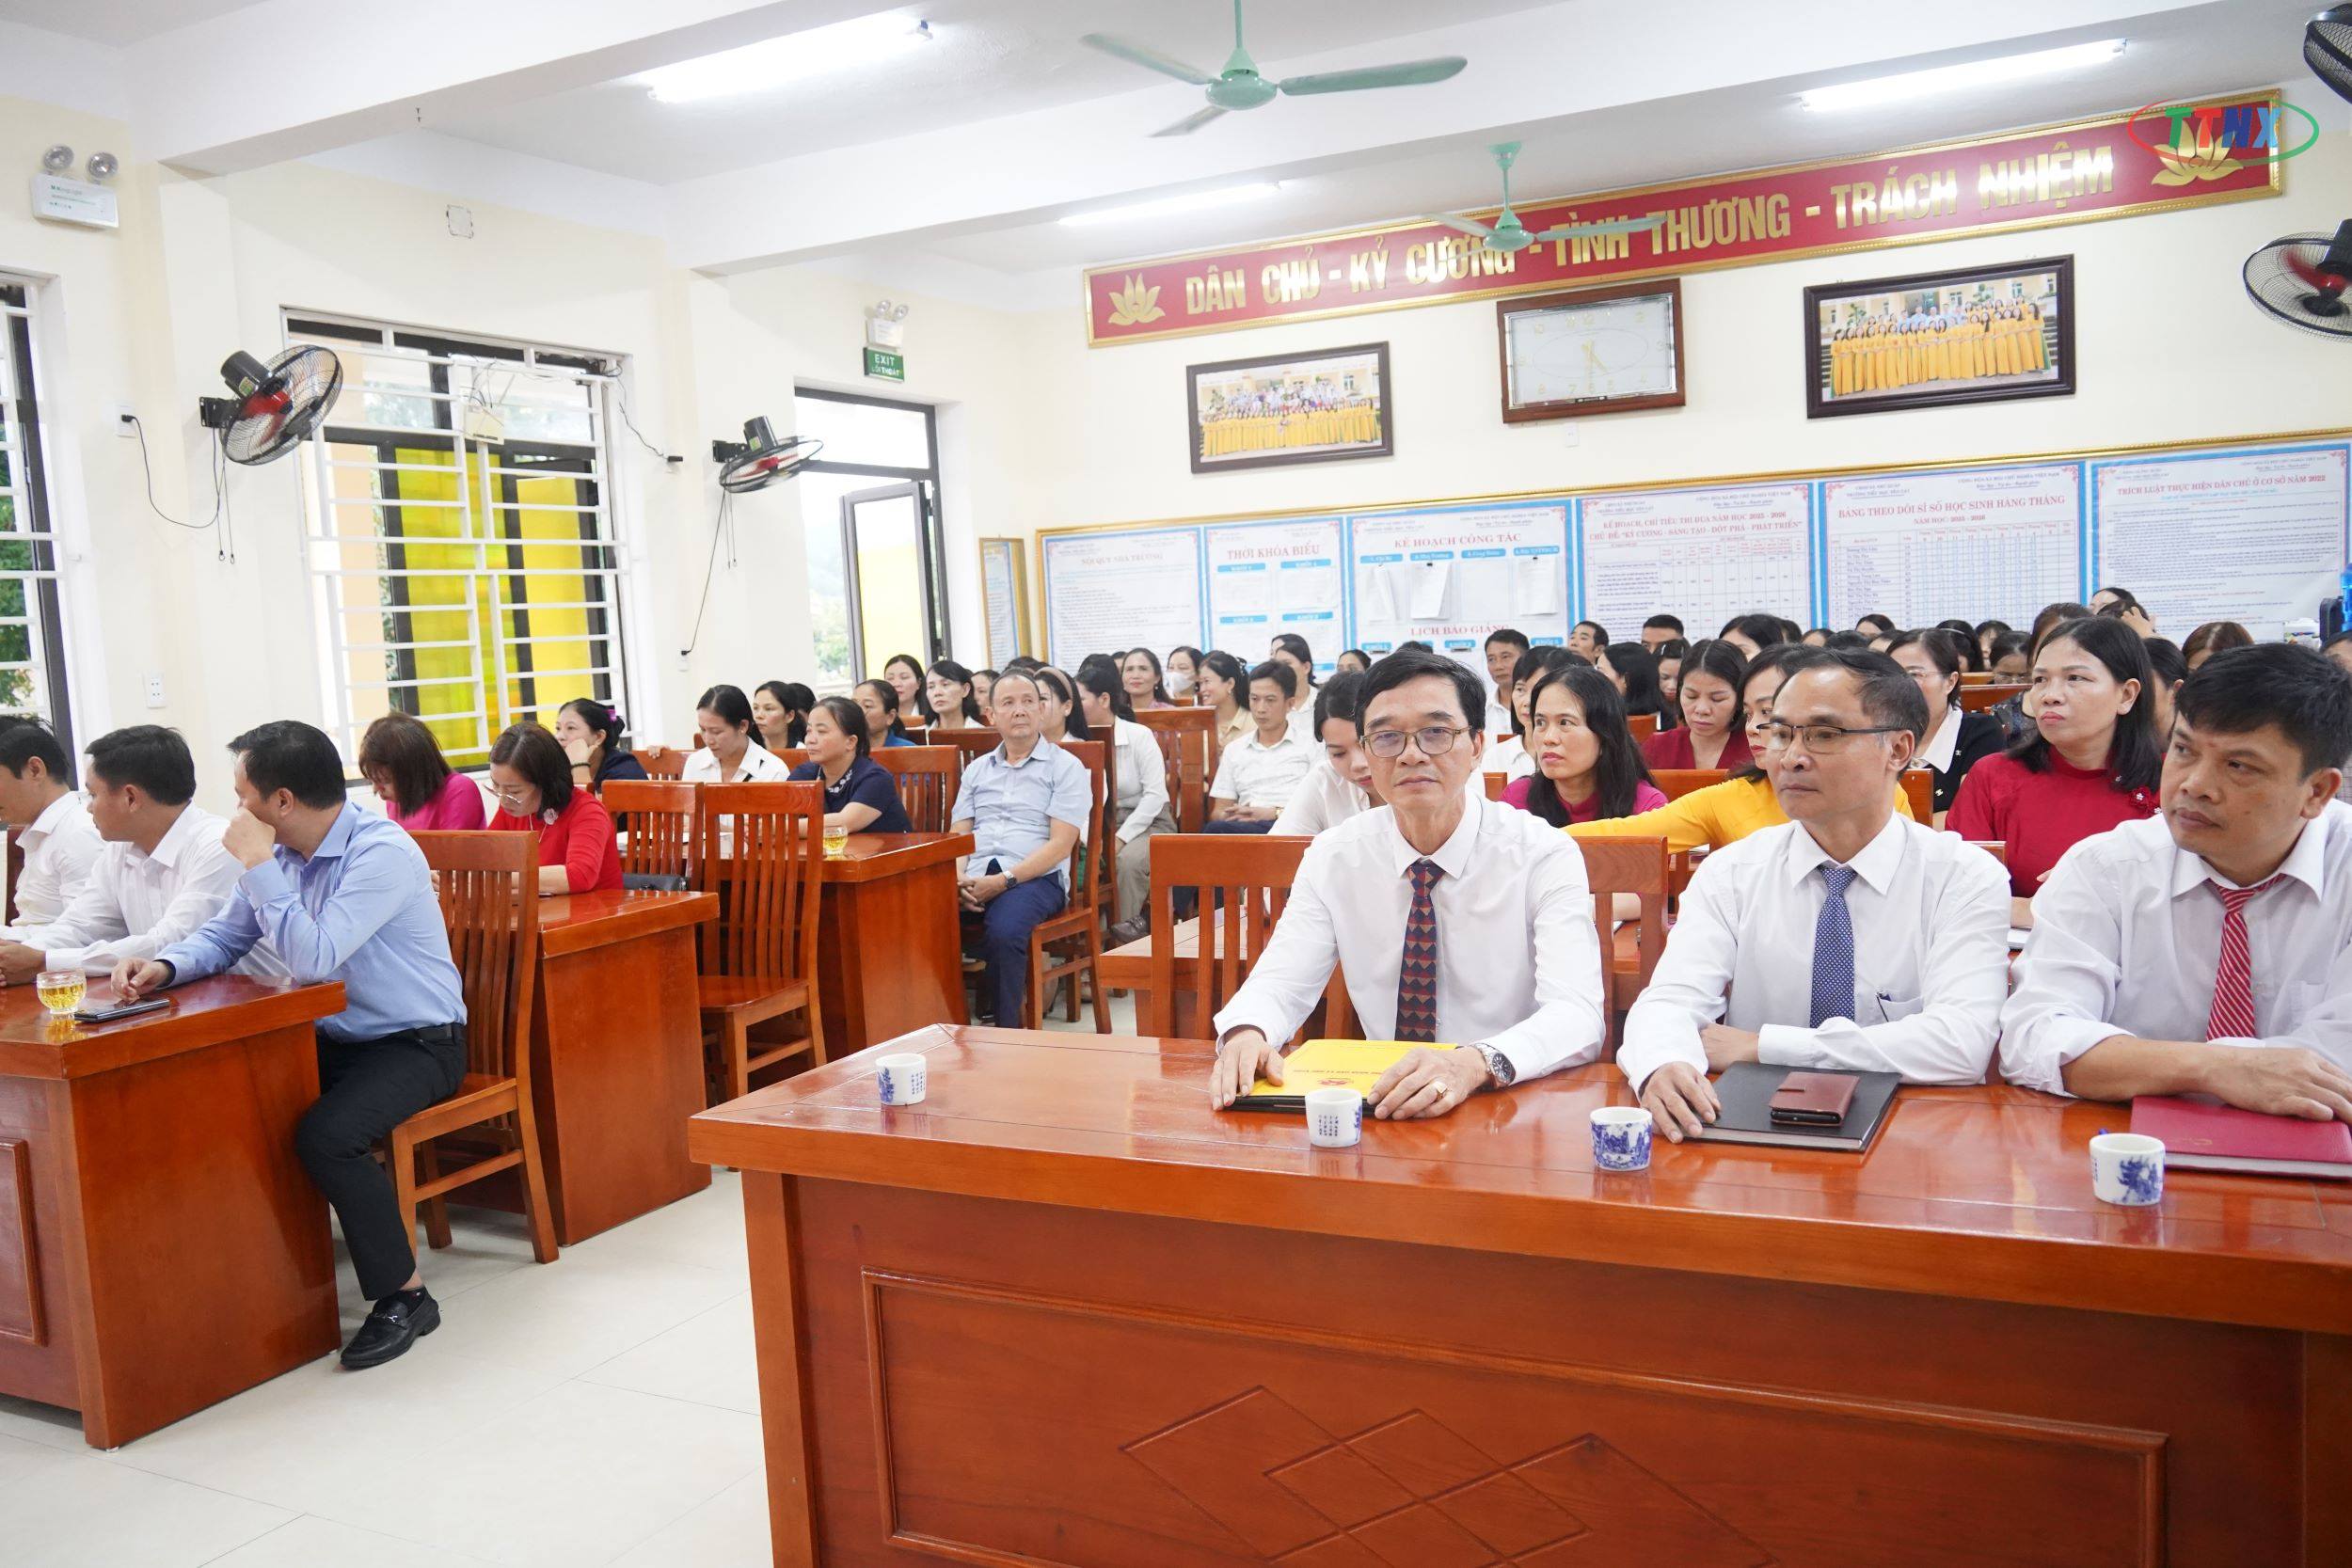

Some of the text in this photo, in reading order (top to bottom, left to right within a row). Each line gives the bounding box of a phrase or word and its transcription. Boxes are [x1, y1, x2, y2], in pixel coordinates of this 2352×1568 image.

[1185, 264, 1247, 315] DÂN
[1262, 245, 1321, 305] CHỦ
[1328, 269, 1343, 280] -
[1349, 235, 1390, 293] KỶ
[1529, 244, 1543, 254] -
[1549, 212, 1629, 267] TÌNH
[1646, 193, 1791, 255] THƯƠNG
[1805, 205, 1821, 217] -
[1830, 166, 1958, 230] TRÁCH
[1978, 140, 2114, 210] NHIỆM
[875, 354, 895, 366] EXIT
[2308, 474, 2326, 483] 2022
[1838, 506, 1866, 518] BẢNG
[1867, 506, 1895, 516] THEO
[1945, 501, 1967, 514] HỌC
[1968, 499, 1994, 510] SINH
[1996, 497, 2026, 508] HÀNG
[2028, 494, 2066, 506] THÁNG
[1749, 512, 1765, 520] 2025
[1771, 511, 1787, 519] 2026
[1394, 531, 1521, 548] KẾ HOẠCH CÔNG TÁC
[1227, 539, 1321, 560] THỜI KHÓA BIỂU
[1411, 626, 1442, 637] LỊCH
[1443, 624, 1468, 635] BÁO
